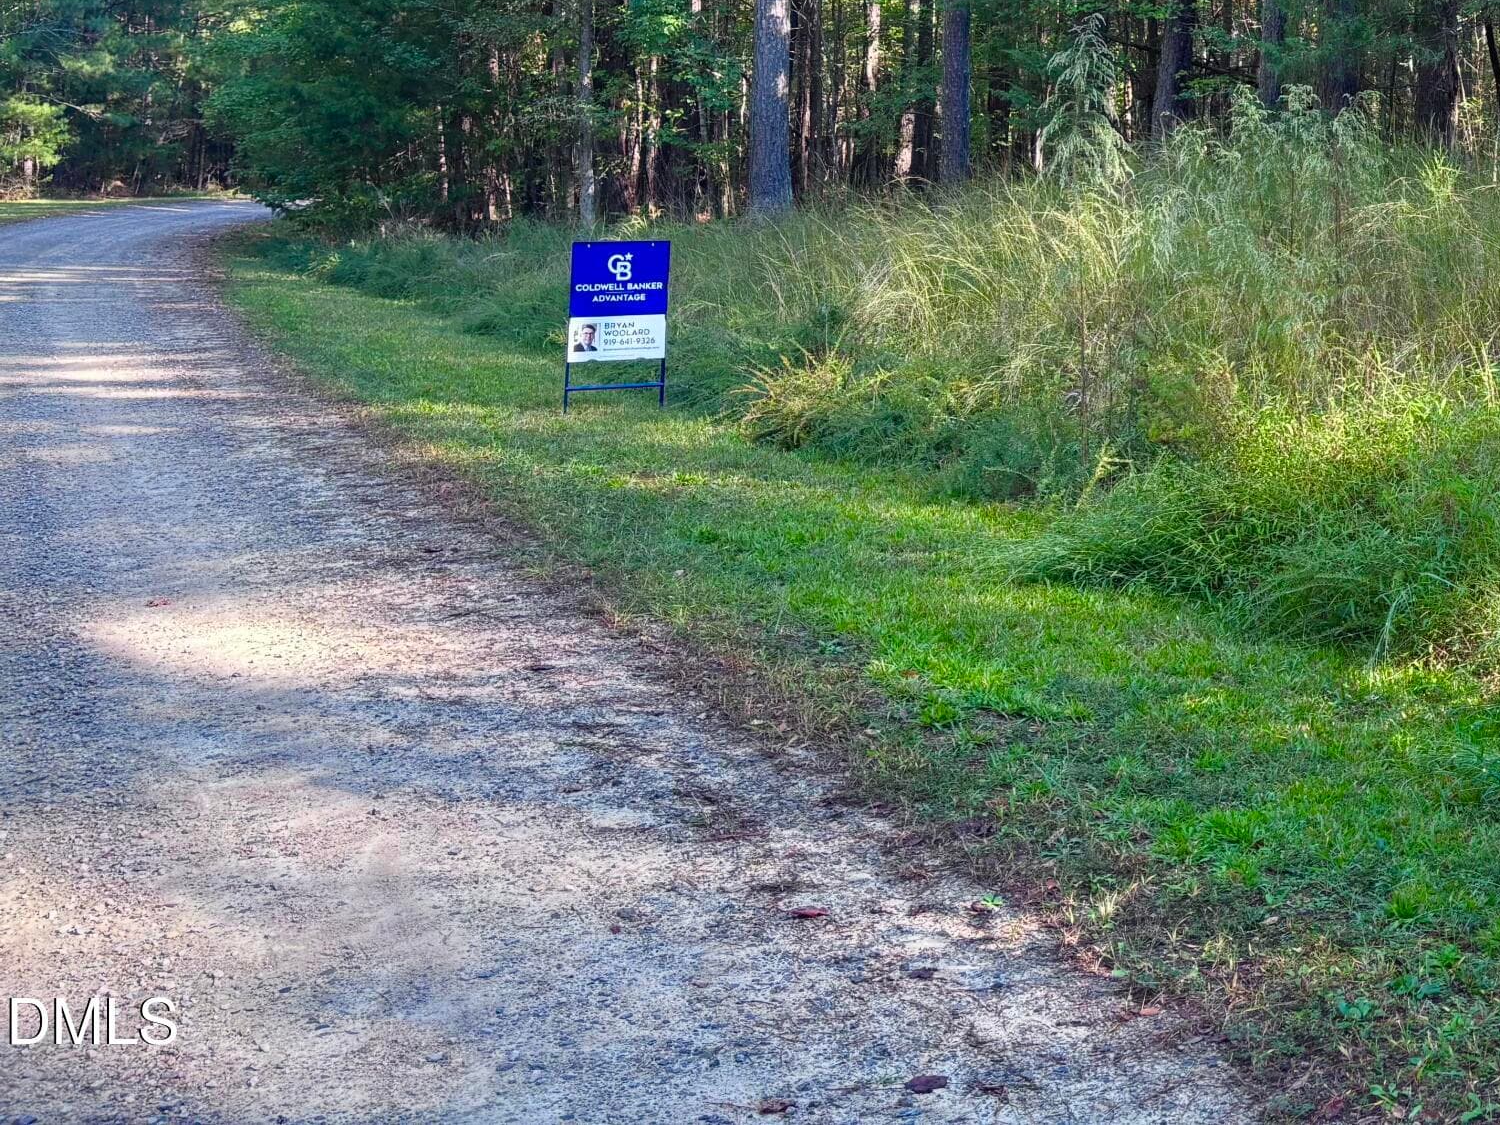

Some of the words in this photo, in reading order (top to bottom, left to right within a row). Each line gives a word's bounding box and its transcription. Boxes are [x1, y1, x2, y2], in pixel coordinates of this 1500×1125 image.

[607, 254, 632, 281] CB
[575, 283, 625, 292] COLDWELL
[627, 281, 663, 290] BANKER
[592, 293, 646, 302] ADVANTAGE
[604, 328, 650, 336] WOOLARD
[603, 337, 656, 346] 919-641-9326
